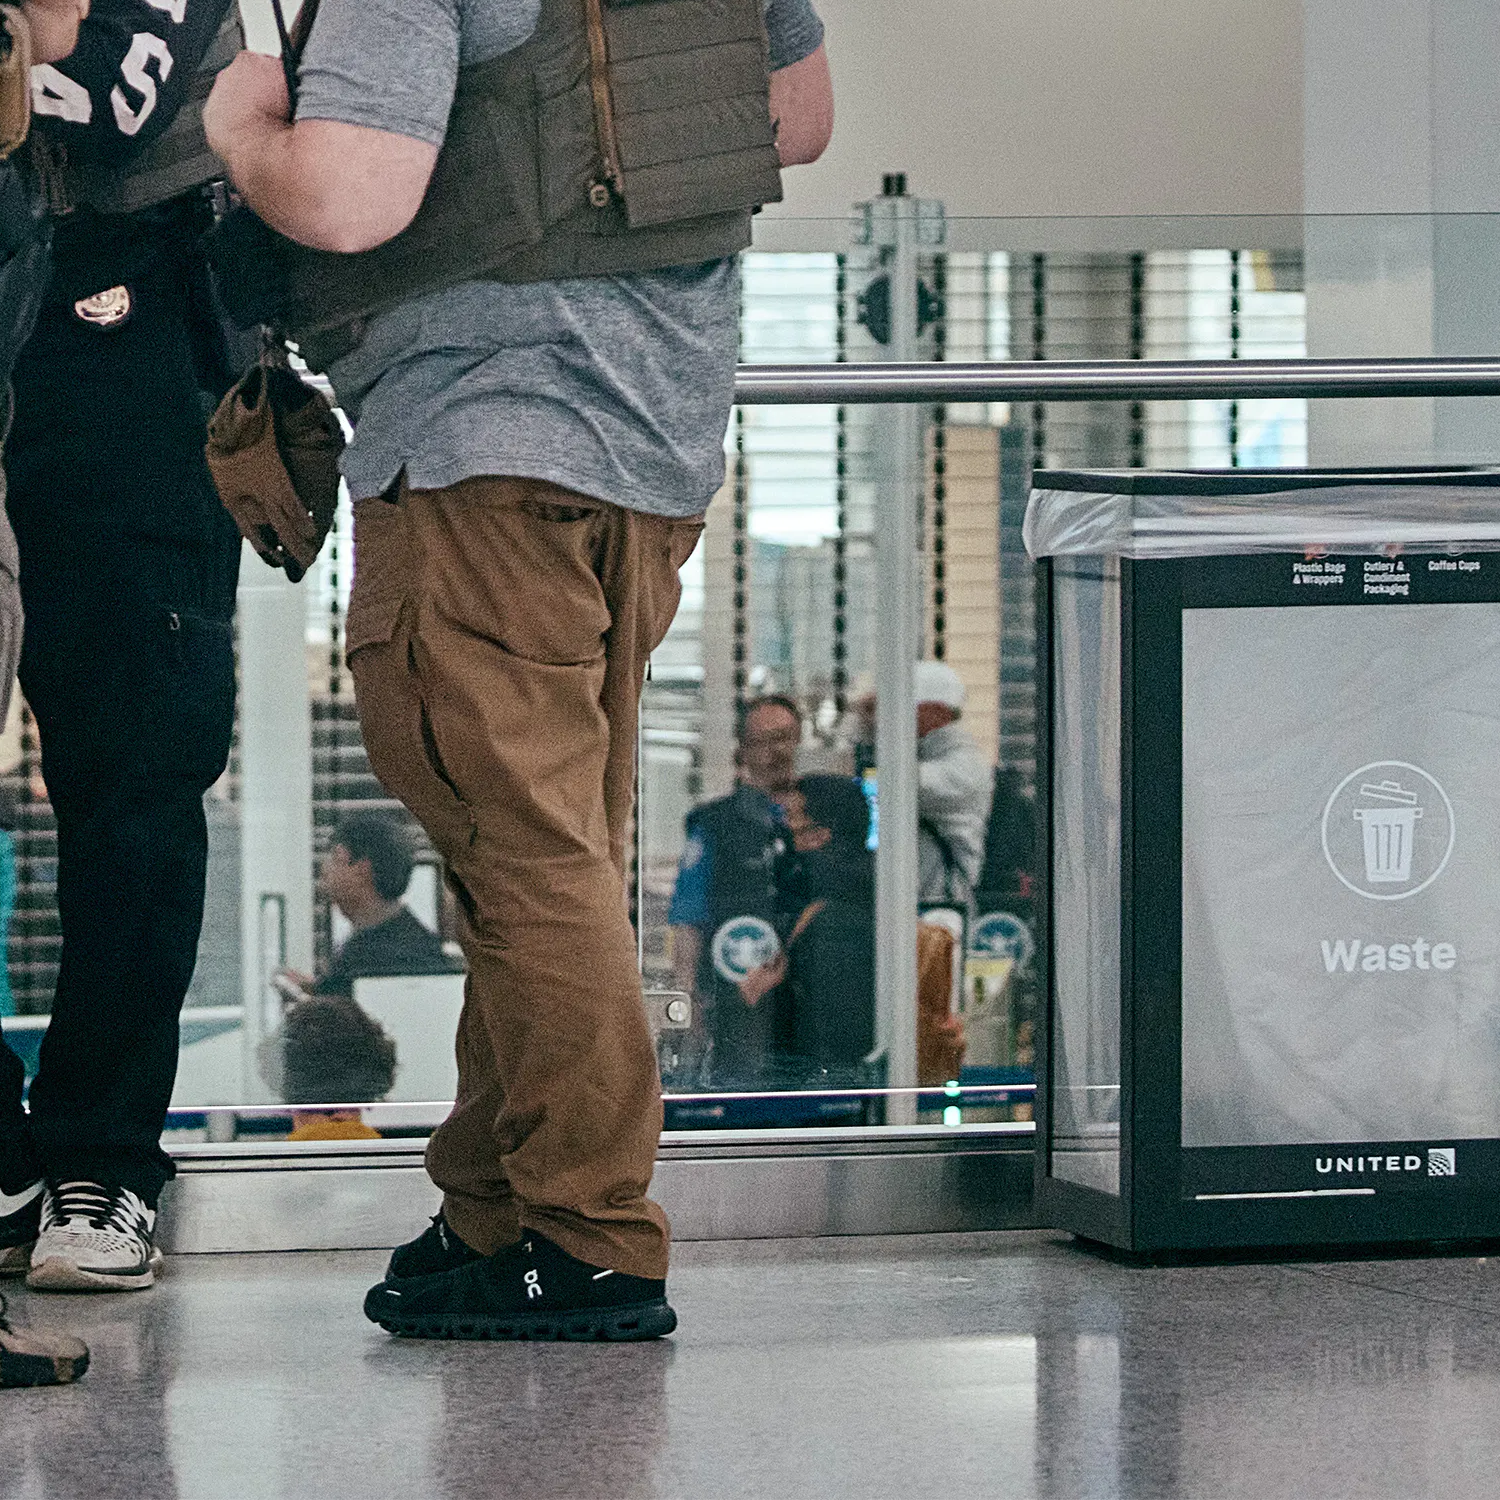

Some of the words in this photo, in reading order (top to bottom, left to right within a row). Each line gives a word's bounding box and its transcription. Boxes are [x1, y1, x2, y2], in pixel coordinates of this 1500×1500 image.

[1293, 562, 1323, 573] Plastic
[1324, 562, 1346, 574] Bags
[1363, 561, 1395, 573] Cutlery
[1428, 560, 1457, 571] Coffee
[1458, 560, 1480, 572] Cups
[1302, 574, 1344, 586] Wrappers
[1363, 572, 1410, 583] Condiment
[1363, 584, 1409, 596] Packaging
[1320, 937, 1457, 973] Waste
[1316, 1155, 1422, 1173] UNITED
